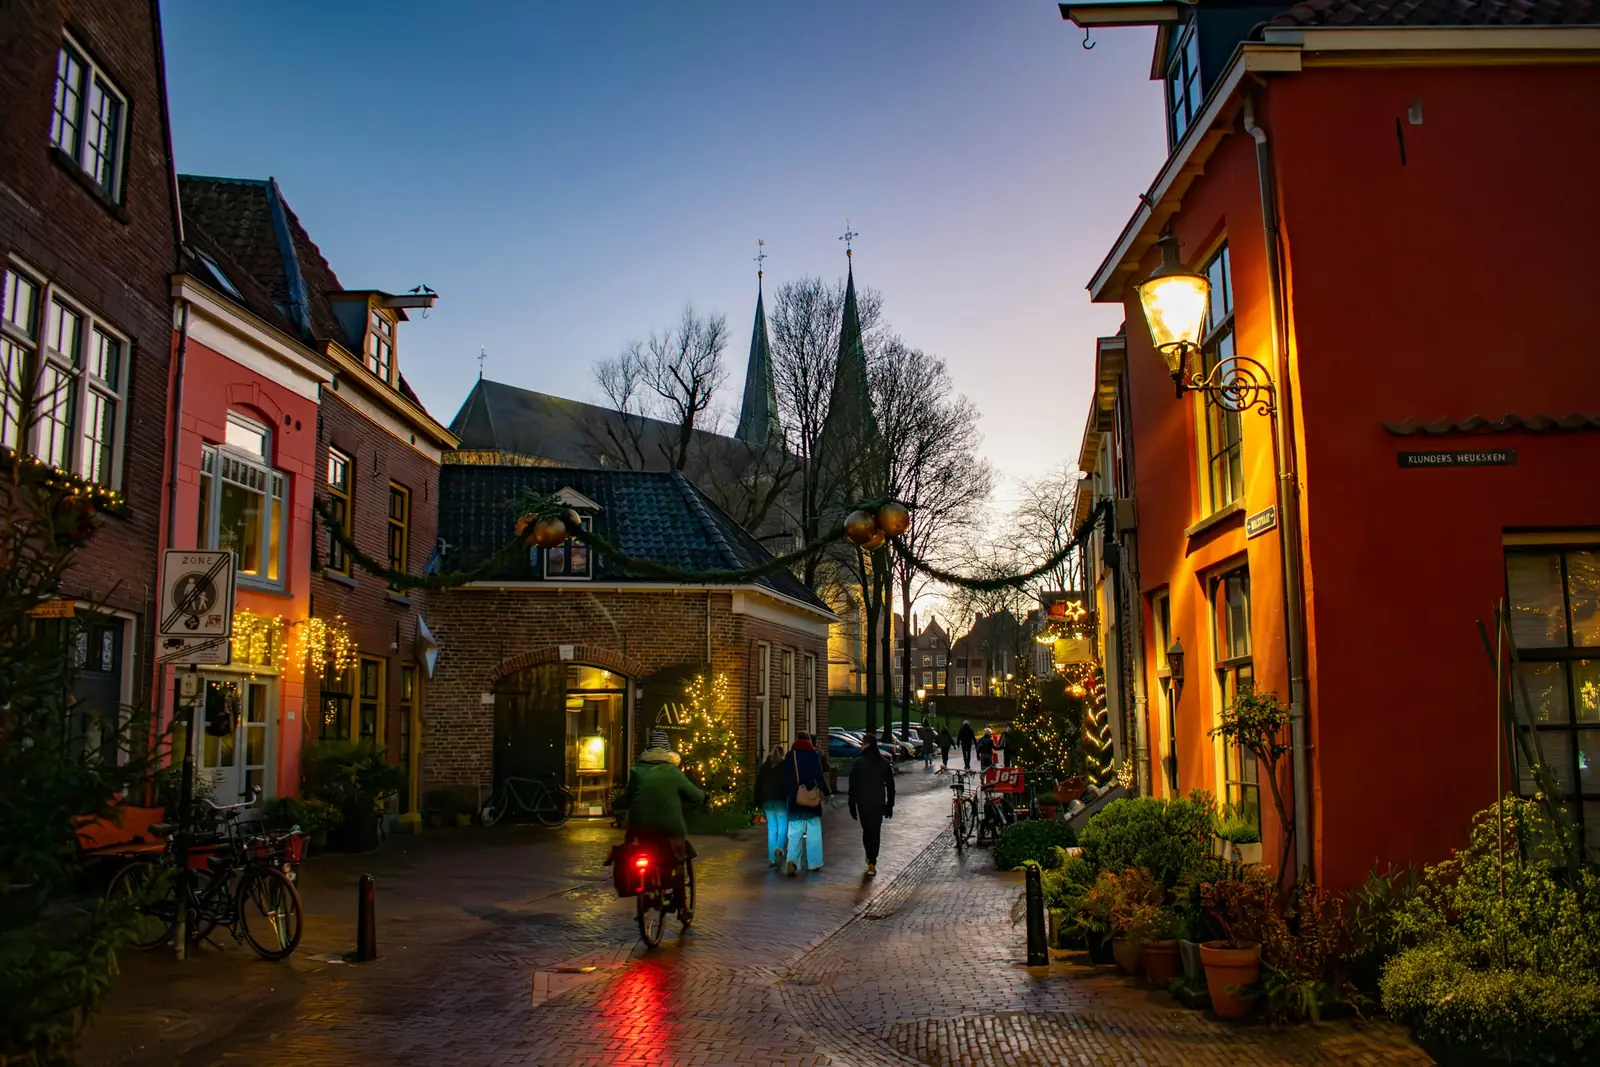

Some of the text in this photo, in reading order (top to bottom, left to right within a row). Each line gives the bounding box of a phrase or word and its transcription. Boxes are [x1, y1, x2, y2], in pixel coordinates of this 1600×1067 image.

[1408, 453, 1506, 464] KLUNDERS HEUKSKEN
[182, 556, 213, 565] ZONE
